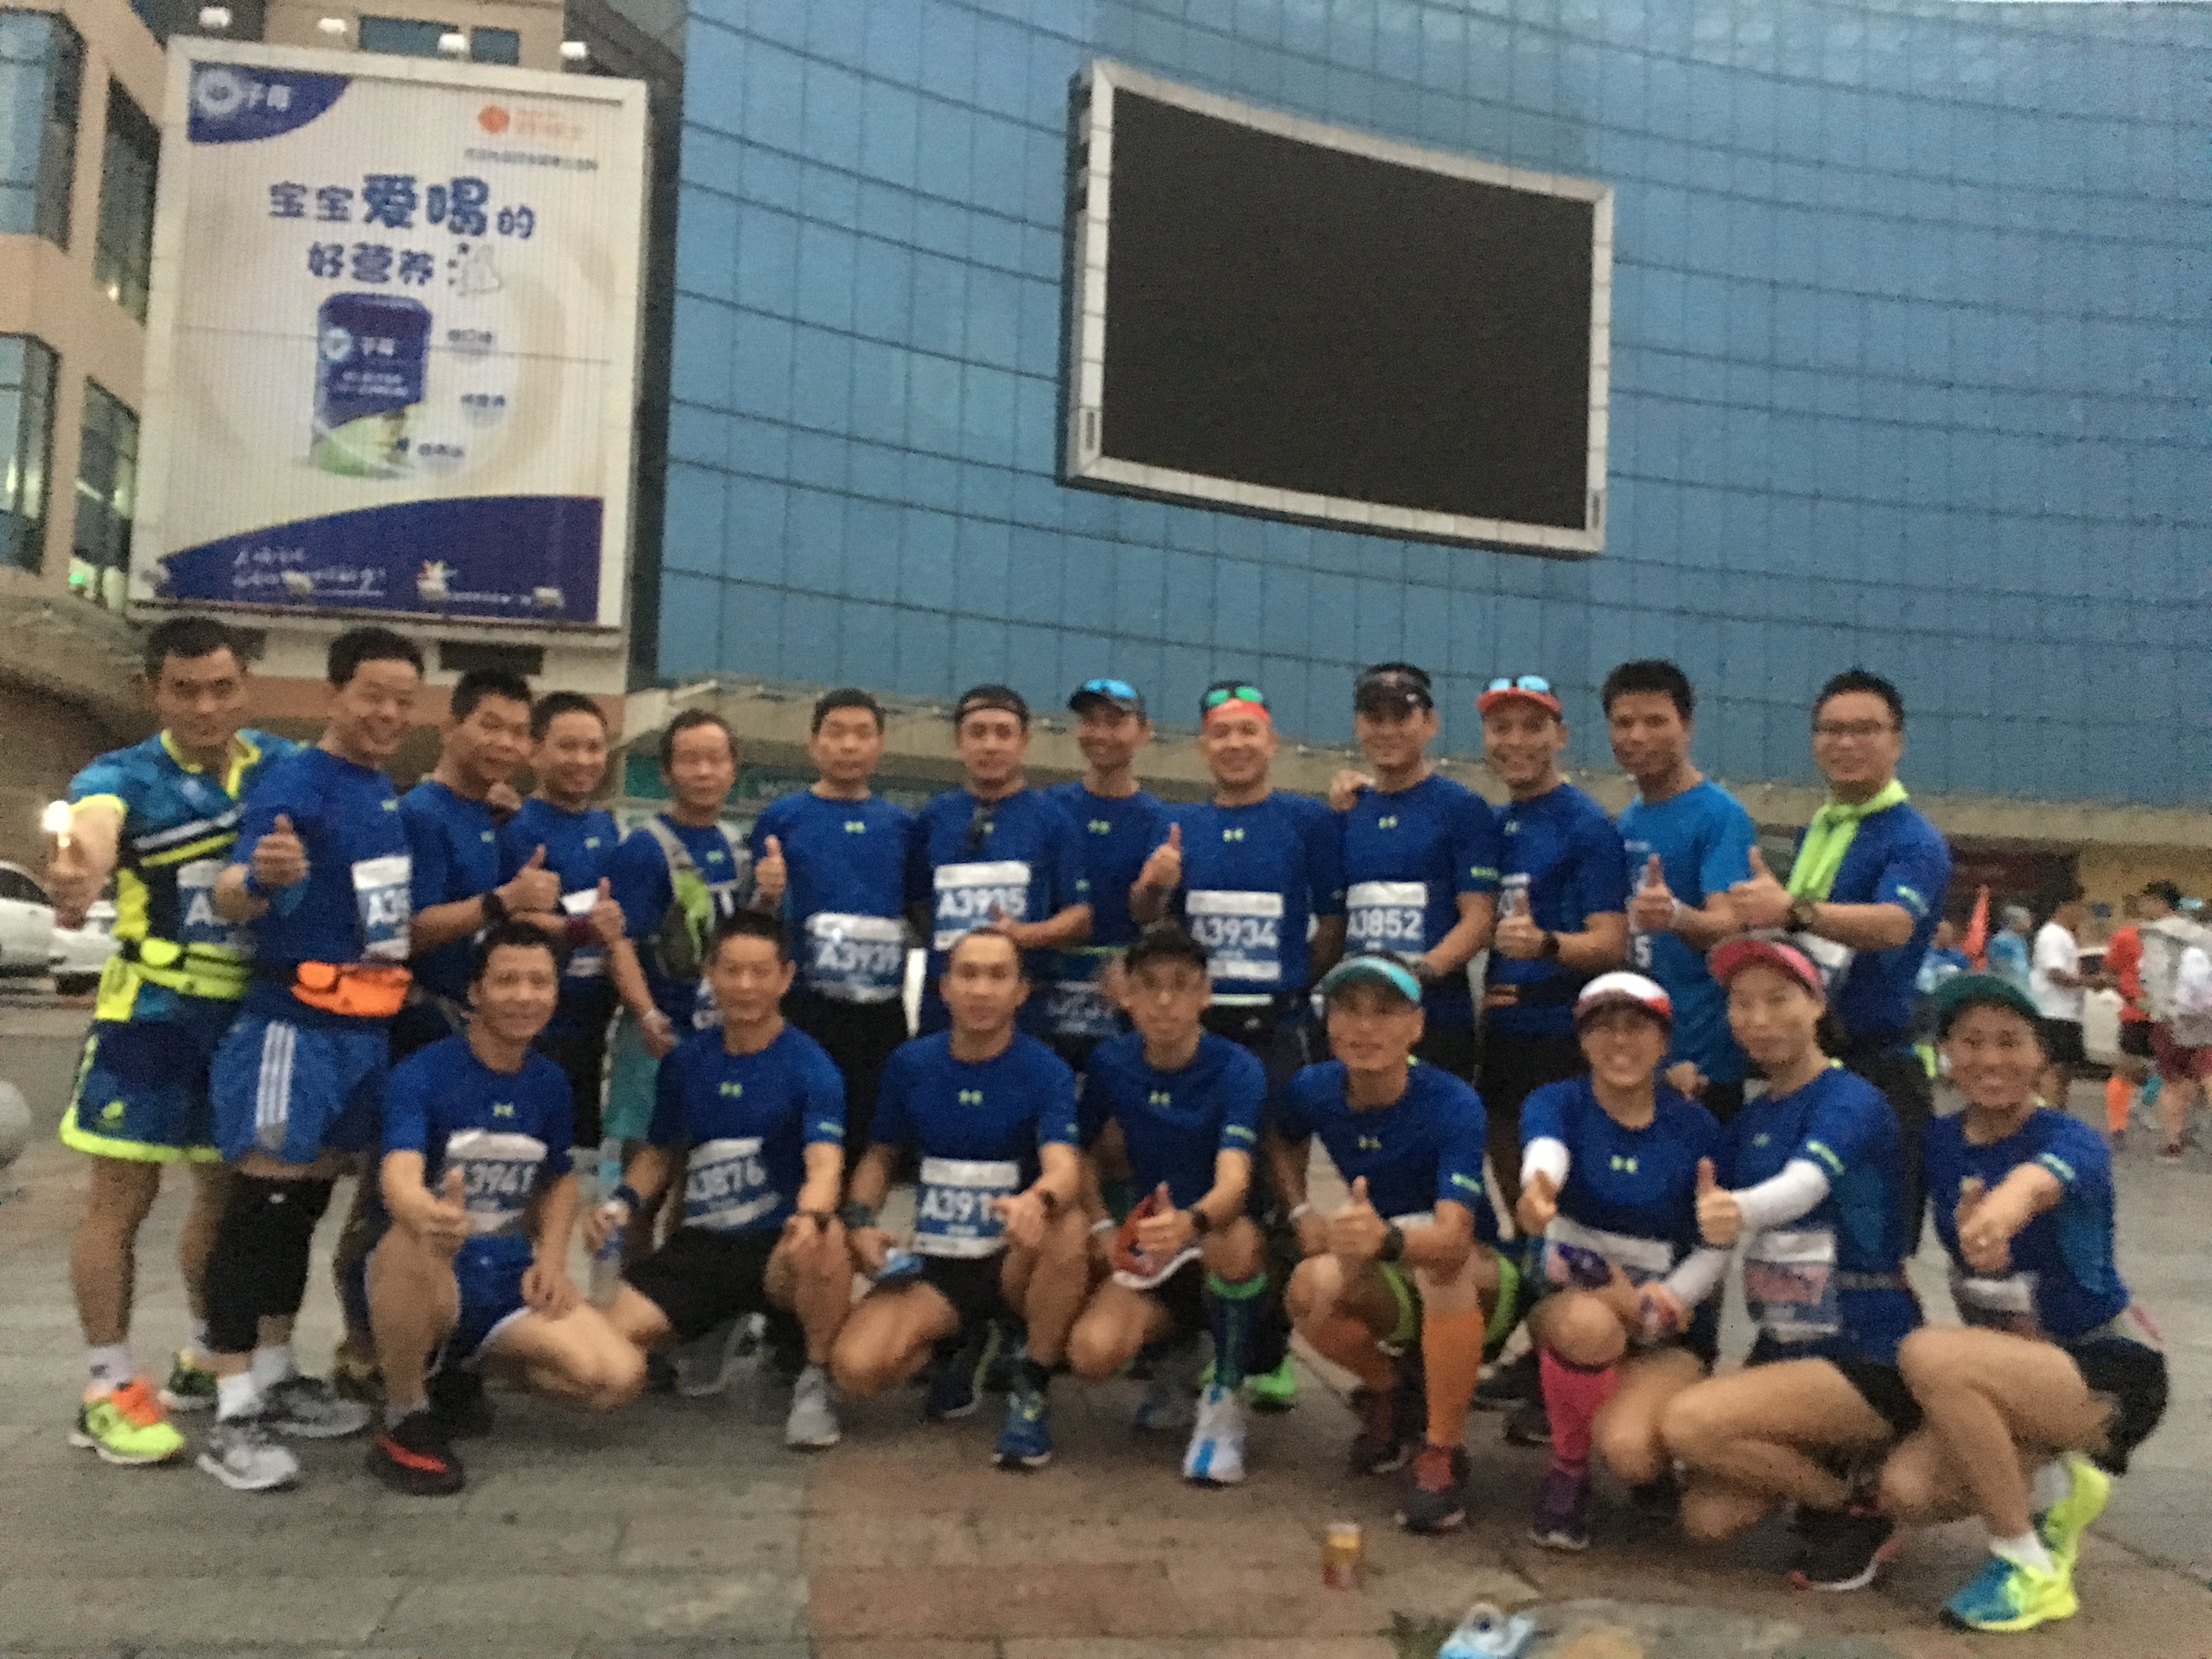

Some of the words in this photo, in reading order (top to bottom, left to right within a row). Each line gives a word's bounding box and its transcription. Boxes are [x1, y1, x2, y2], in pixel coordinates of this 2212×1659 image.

[269, 174, 535, 239] 宝宝爱喝的
[920, 1188, 1006, 1224] A391
